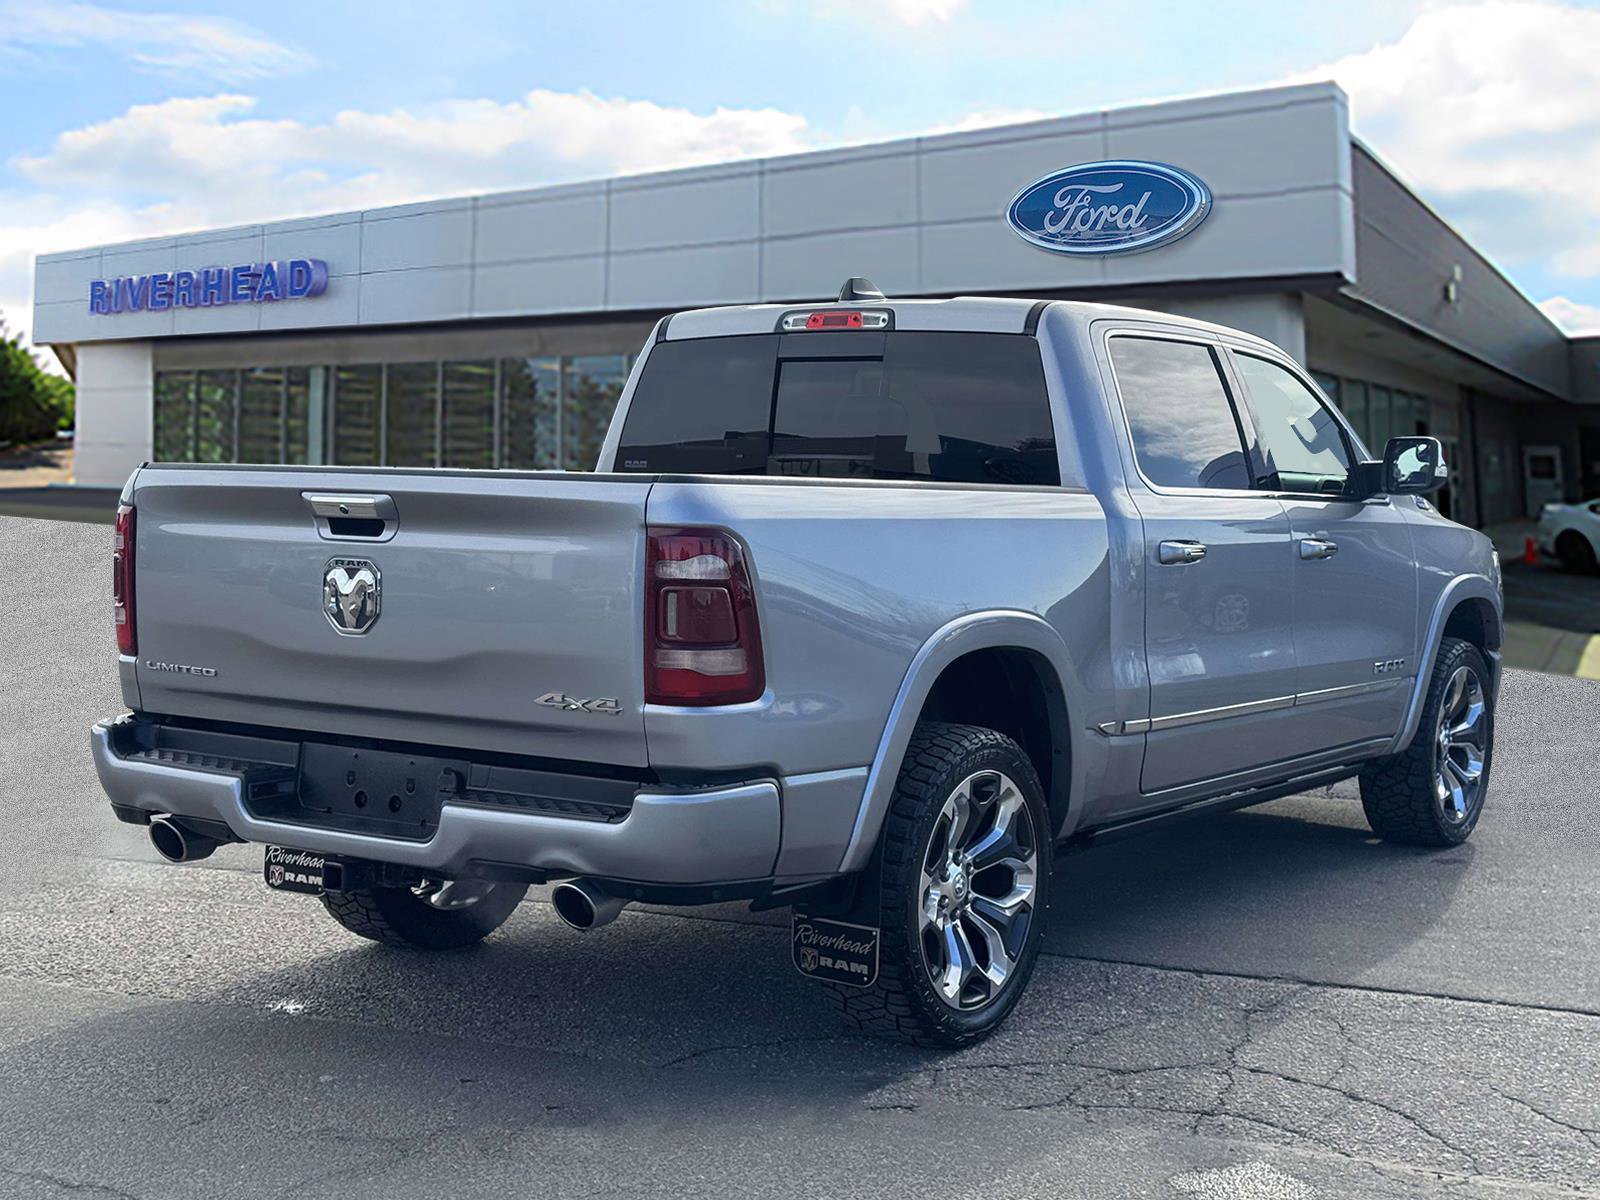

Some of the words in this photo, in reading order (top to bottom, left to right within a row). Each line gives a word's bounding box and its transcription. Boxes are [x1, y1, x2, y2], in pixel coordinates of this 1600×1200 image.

[1043, 182, 1152, 234] Ford
[89, 259, 326, 314] RIVERHEAD
[145, 660, 218, 677] LIMITED
[284, 871, 323, 886] RAM
[794, 923, 876, 955] Riverhead
[819, 956, 869, 975] RAM
